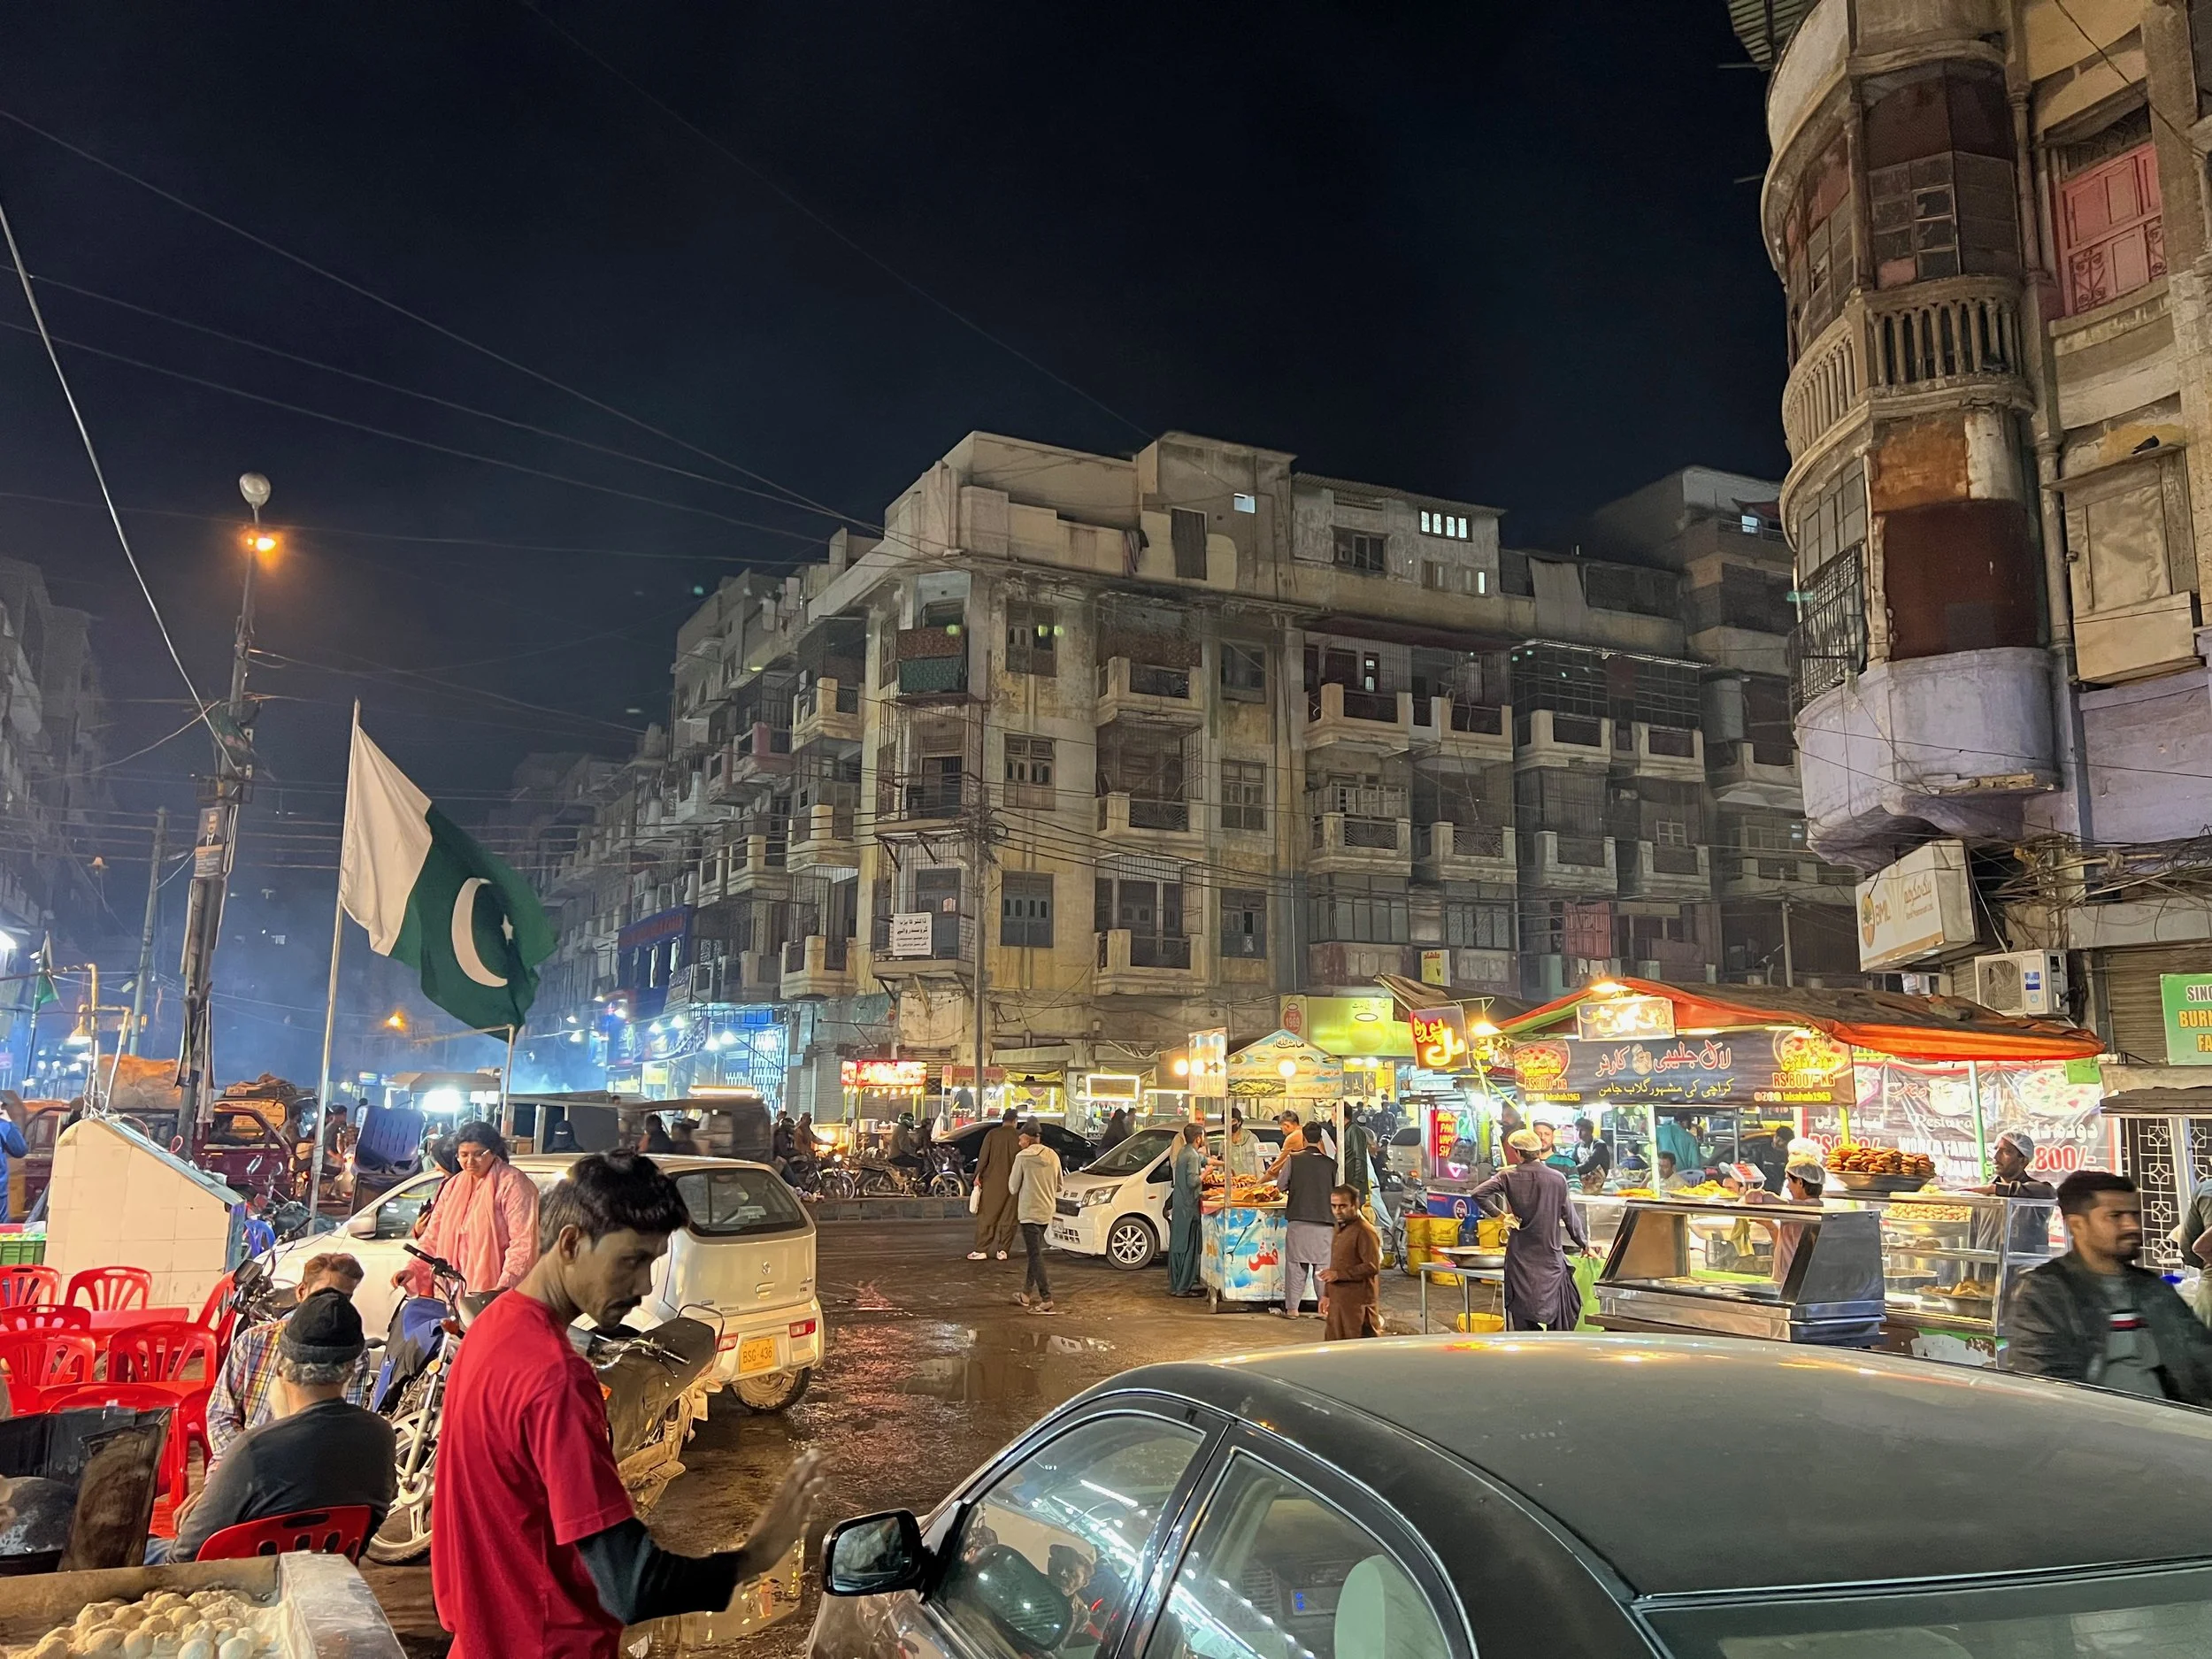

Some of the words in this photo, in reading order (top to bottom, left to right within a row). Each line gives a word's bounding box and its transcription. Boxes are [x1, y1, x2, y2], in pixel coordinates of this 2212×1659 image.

[1875, 899, 1891, 926] BML
[1595, 1045, 1630, 1077] کارنر
[1654, 1041, 1699, 1073] جلیبی
[1598, 1082, 1623, 1097] جامن
[1624, 1078, 1651, 1094] گلاب
[1650, 1082, 1682, 1097] مشہور
[1685, 1079, 1700, 1097] کی
[1701, 1078, 1734, 1098] کراچی
[1821, 1072, 1835, 1087] KG
[1944, 1140, 1995, 1160] FAMOS
[1248, 1240, 1279, 1272] فش
